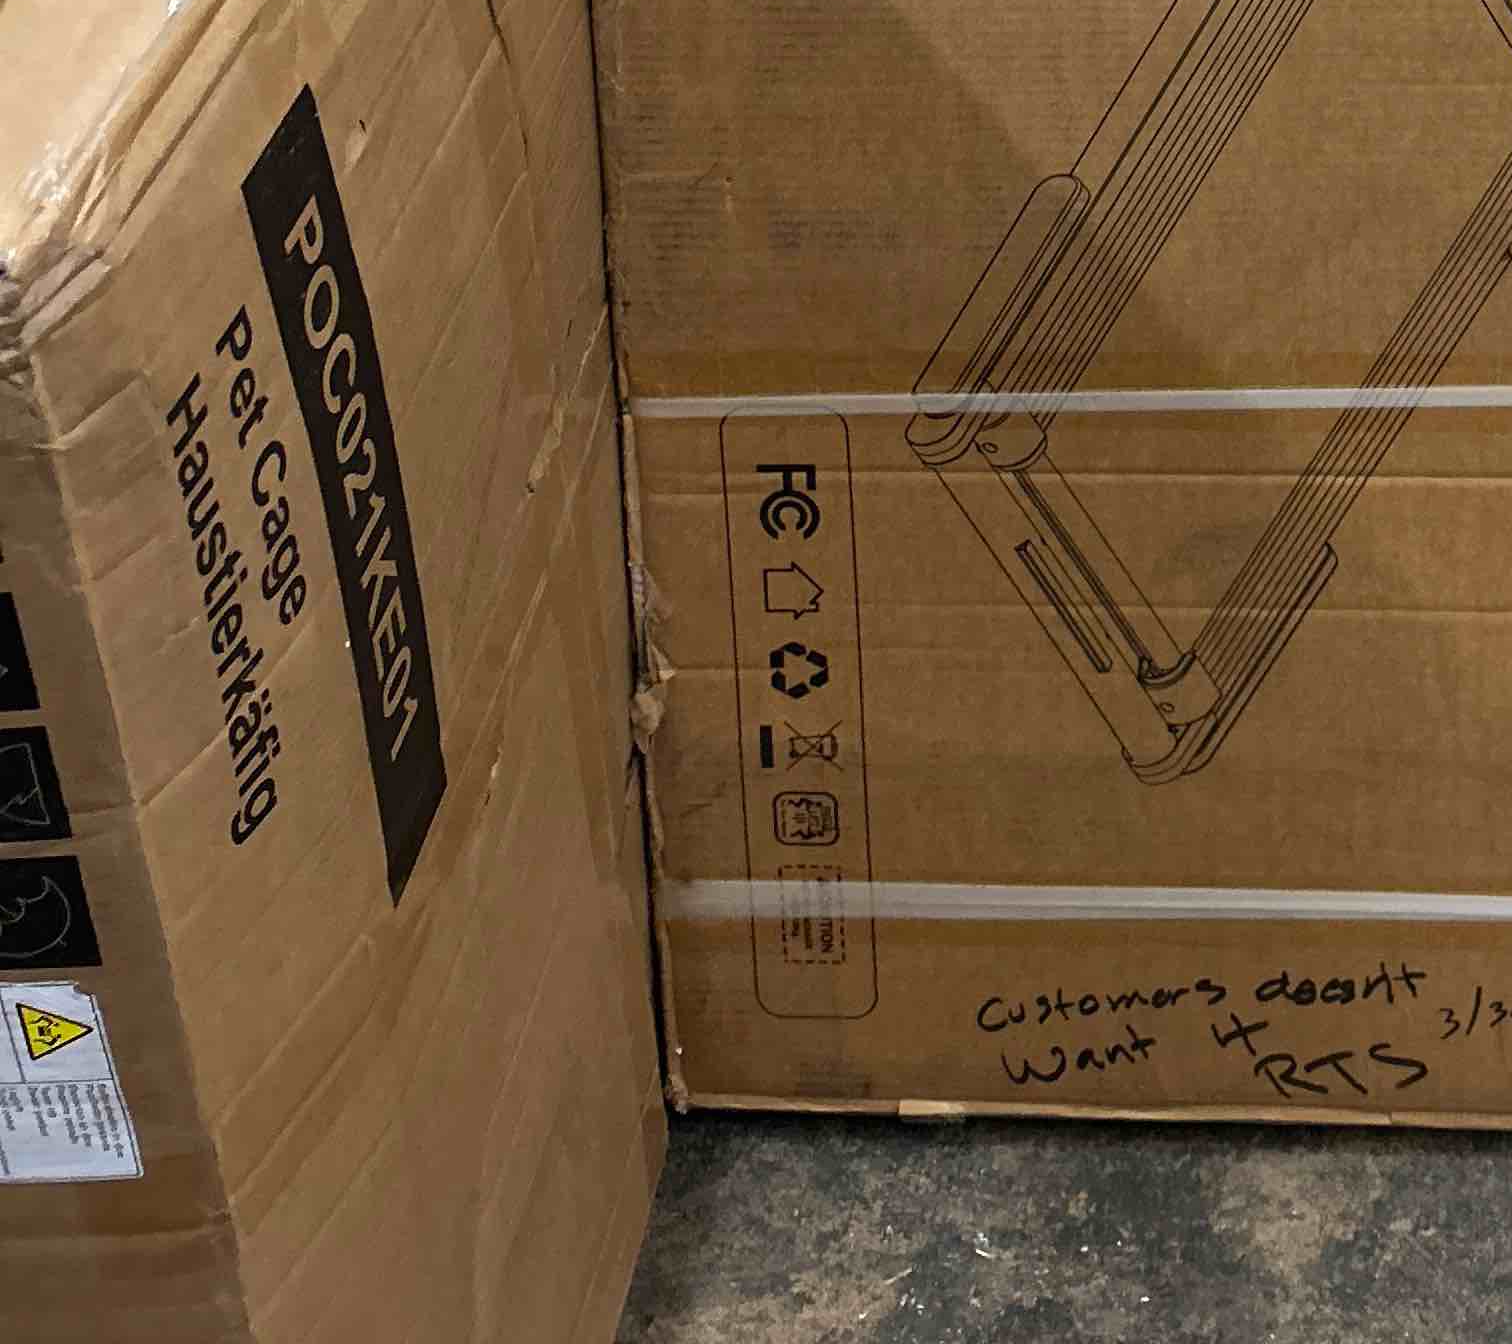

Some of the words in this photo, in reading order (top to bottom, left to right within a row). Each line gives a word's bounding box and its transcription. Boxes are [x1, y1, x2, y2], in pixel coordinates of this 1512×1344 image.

[213, 303, 256, 445] Pet
[241, 438, 310, 629] Cage
[164, 371, 283, 848] Haustierkäfig
[976, 977, 1228, 1033] Customers
[1252, 1042, 1430, 1098] RTS
